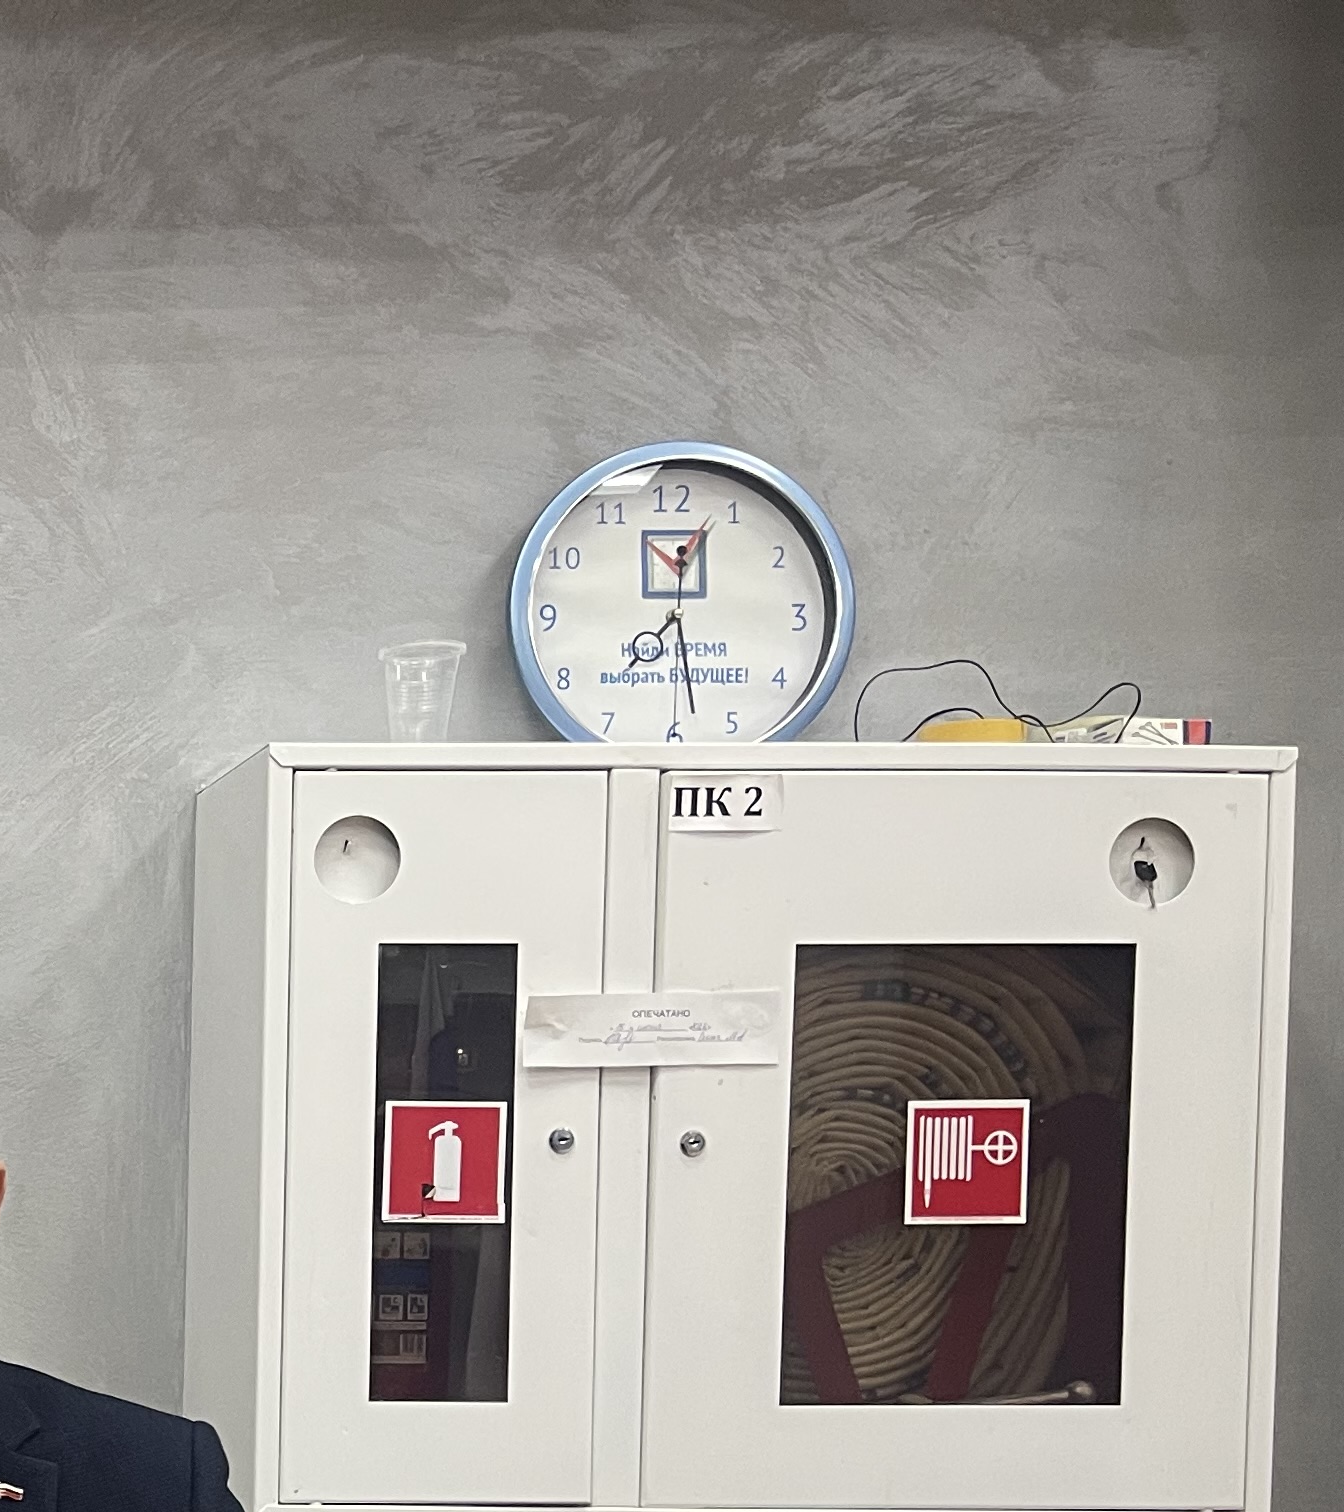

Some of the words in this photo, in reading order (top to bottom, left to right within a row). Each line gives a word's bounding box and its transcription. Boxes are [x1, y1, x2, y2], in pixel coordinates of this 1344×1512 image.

[652, 485, 691, 513] 12
[596, 502, 627, 525] 11
[727, 501, 741, 525] 1
[548, 547, 581, 570] 10
[771, 546, 786, 569] 2
[539, 604, 558, 632] 9
[791, 603, 807, 632] 3
[556, 667, 571, 690] 8
[600, 668, 666, 687] выбрать
[669, 667, 749, 686] БУДУЩЕЕ!
[771, 667, 788, 690] 4
[600, 711, 616, 735] 7
[665, 721, 684, 742] 6
[725, 711, 739, 735] 5
[672, 786, 732, 817] ПК
[743, 786, 763, 817] 2
[631, 1008, 691, 1019] ОПЕЧАТАНО
